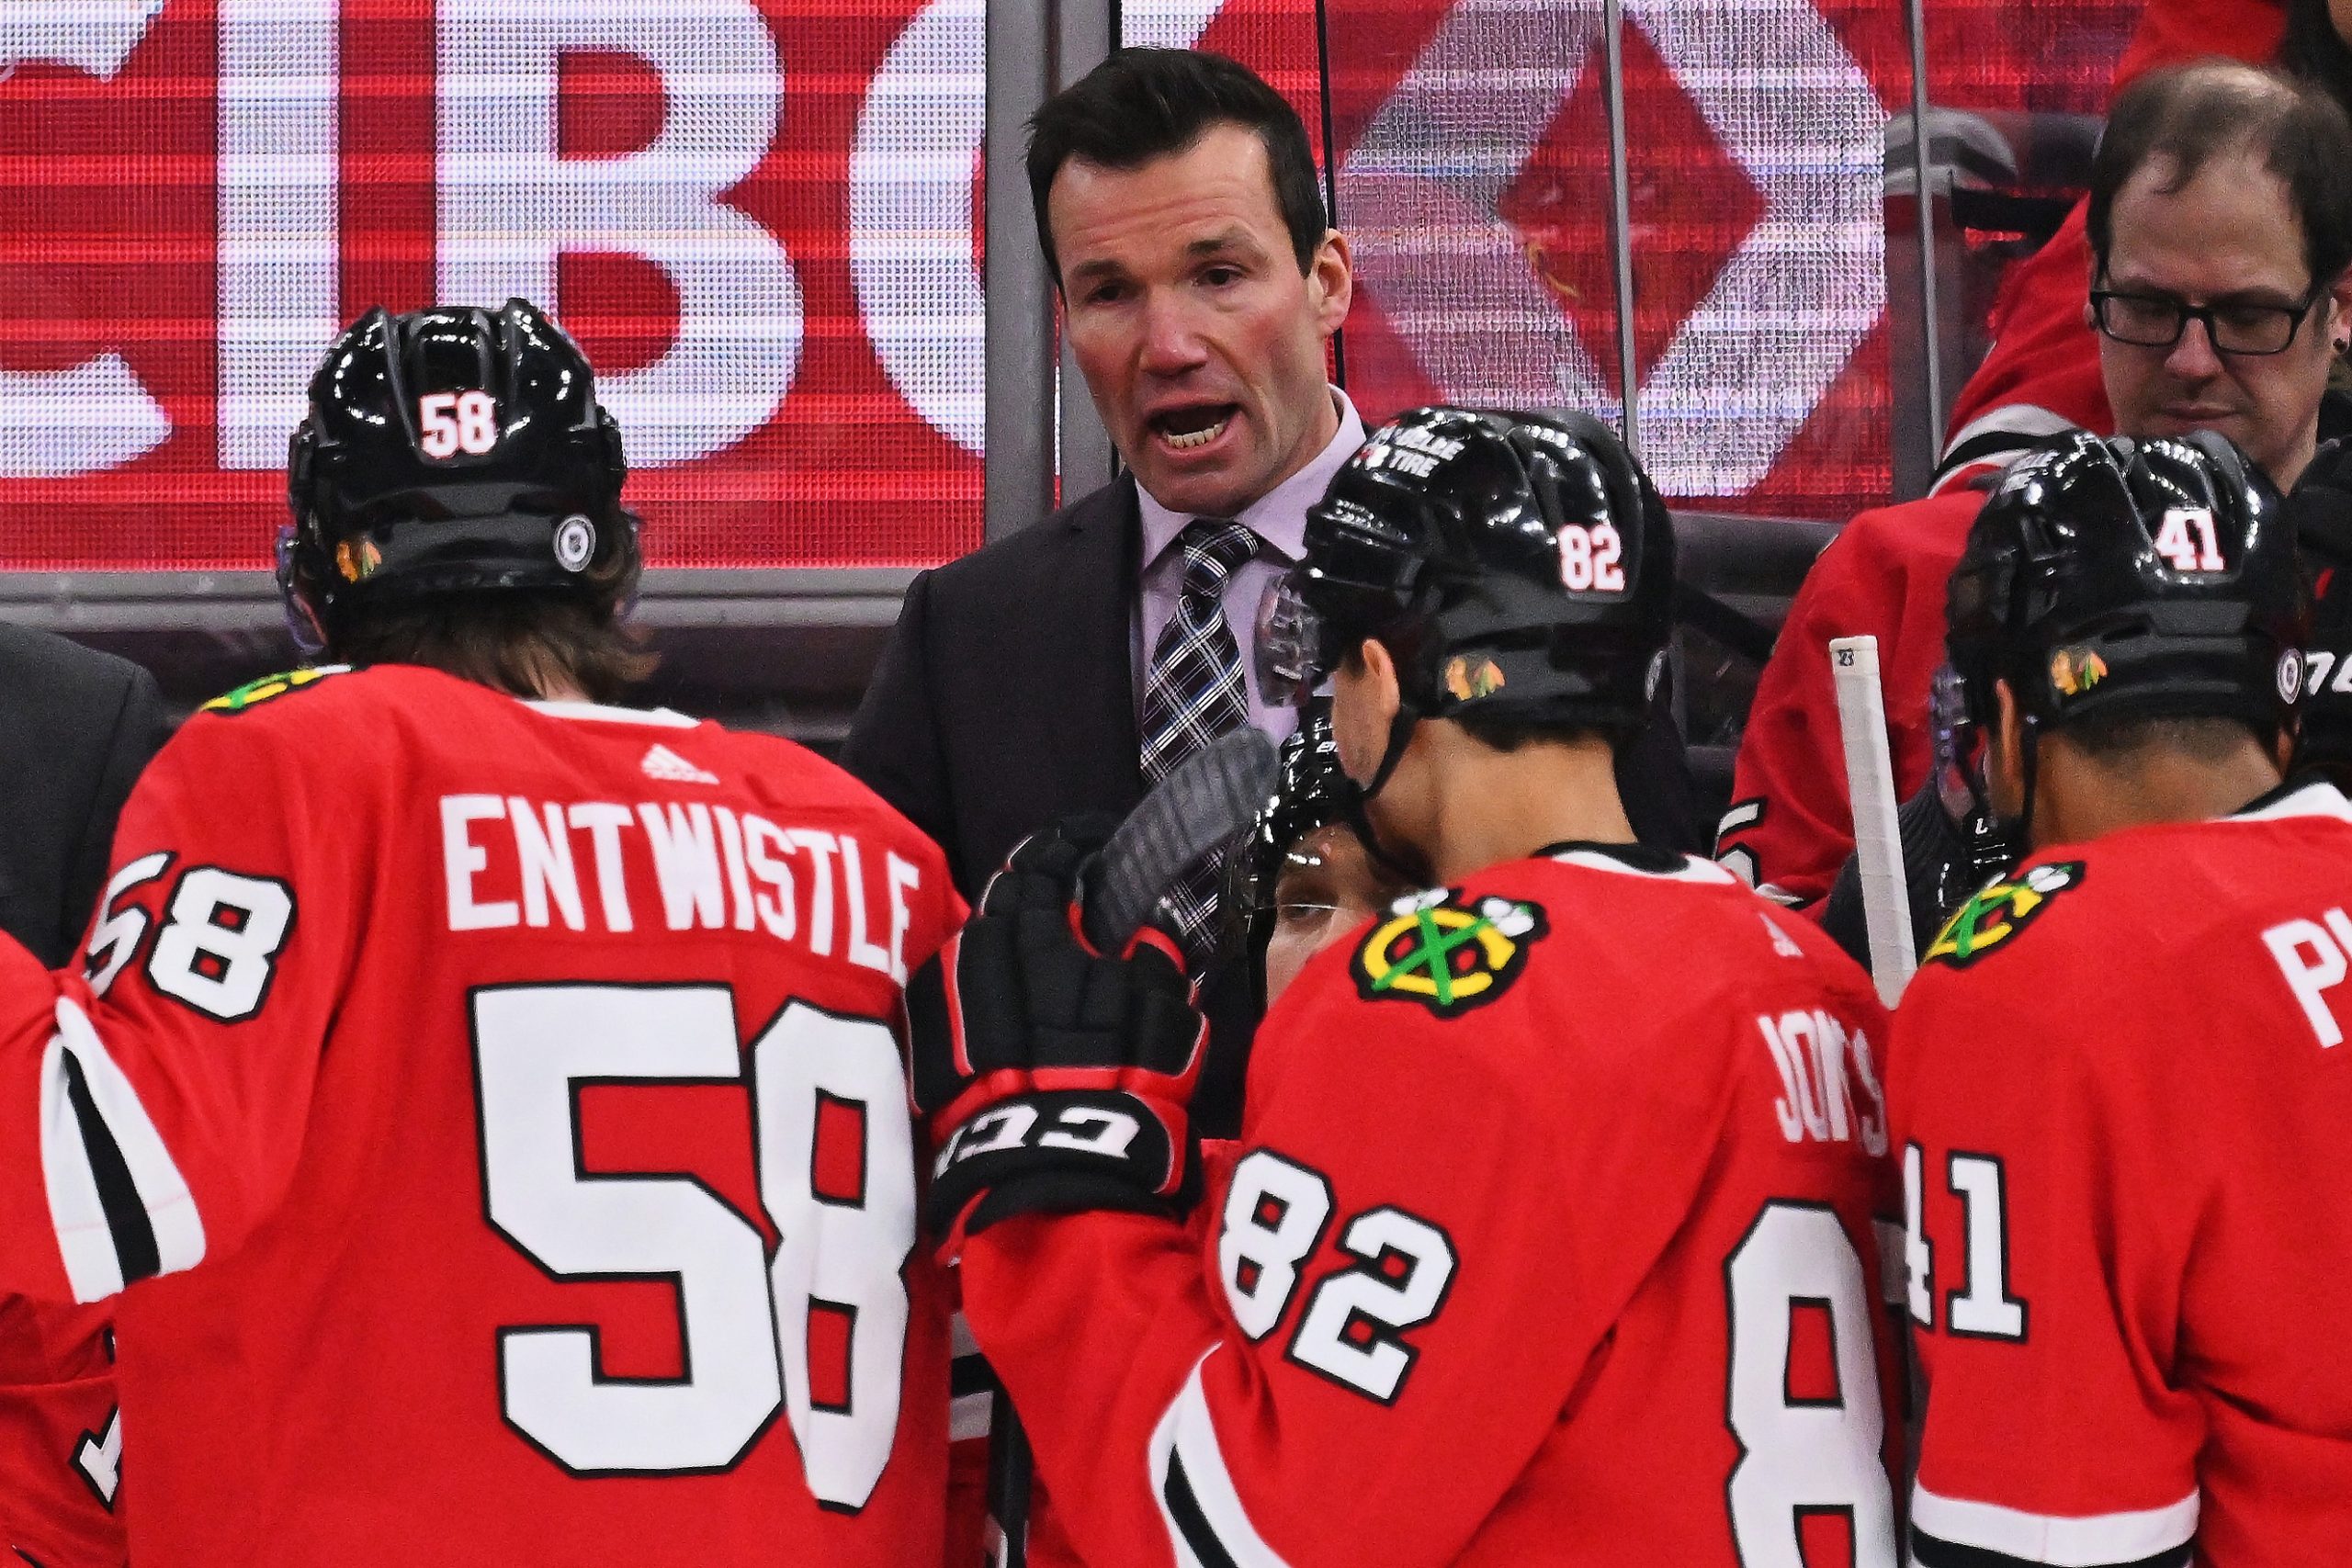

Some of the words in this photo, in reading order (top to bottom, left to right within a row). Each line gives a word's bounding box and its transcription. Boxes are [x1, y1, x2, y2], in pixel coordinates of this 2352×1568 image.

[419, 390, 497, 459] 58
[1387, 447, 1442, 479] TIRE
[1558, 523, 1625, 592] 82
[2154, 509, 2225, 571] 41
[440, 794, 922, 987] ENTWISTLE
[1757, 1009, 1889, 1158] JONS
[466, 980, 919, 1516] 58
[1217, 1145, 1461, 1408] 82
